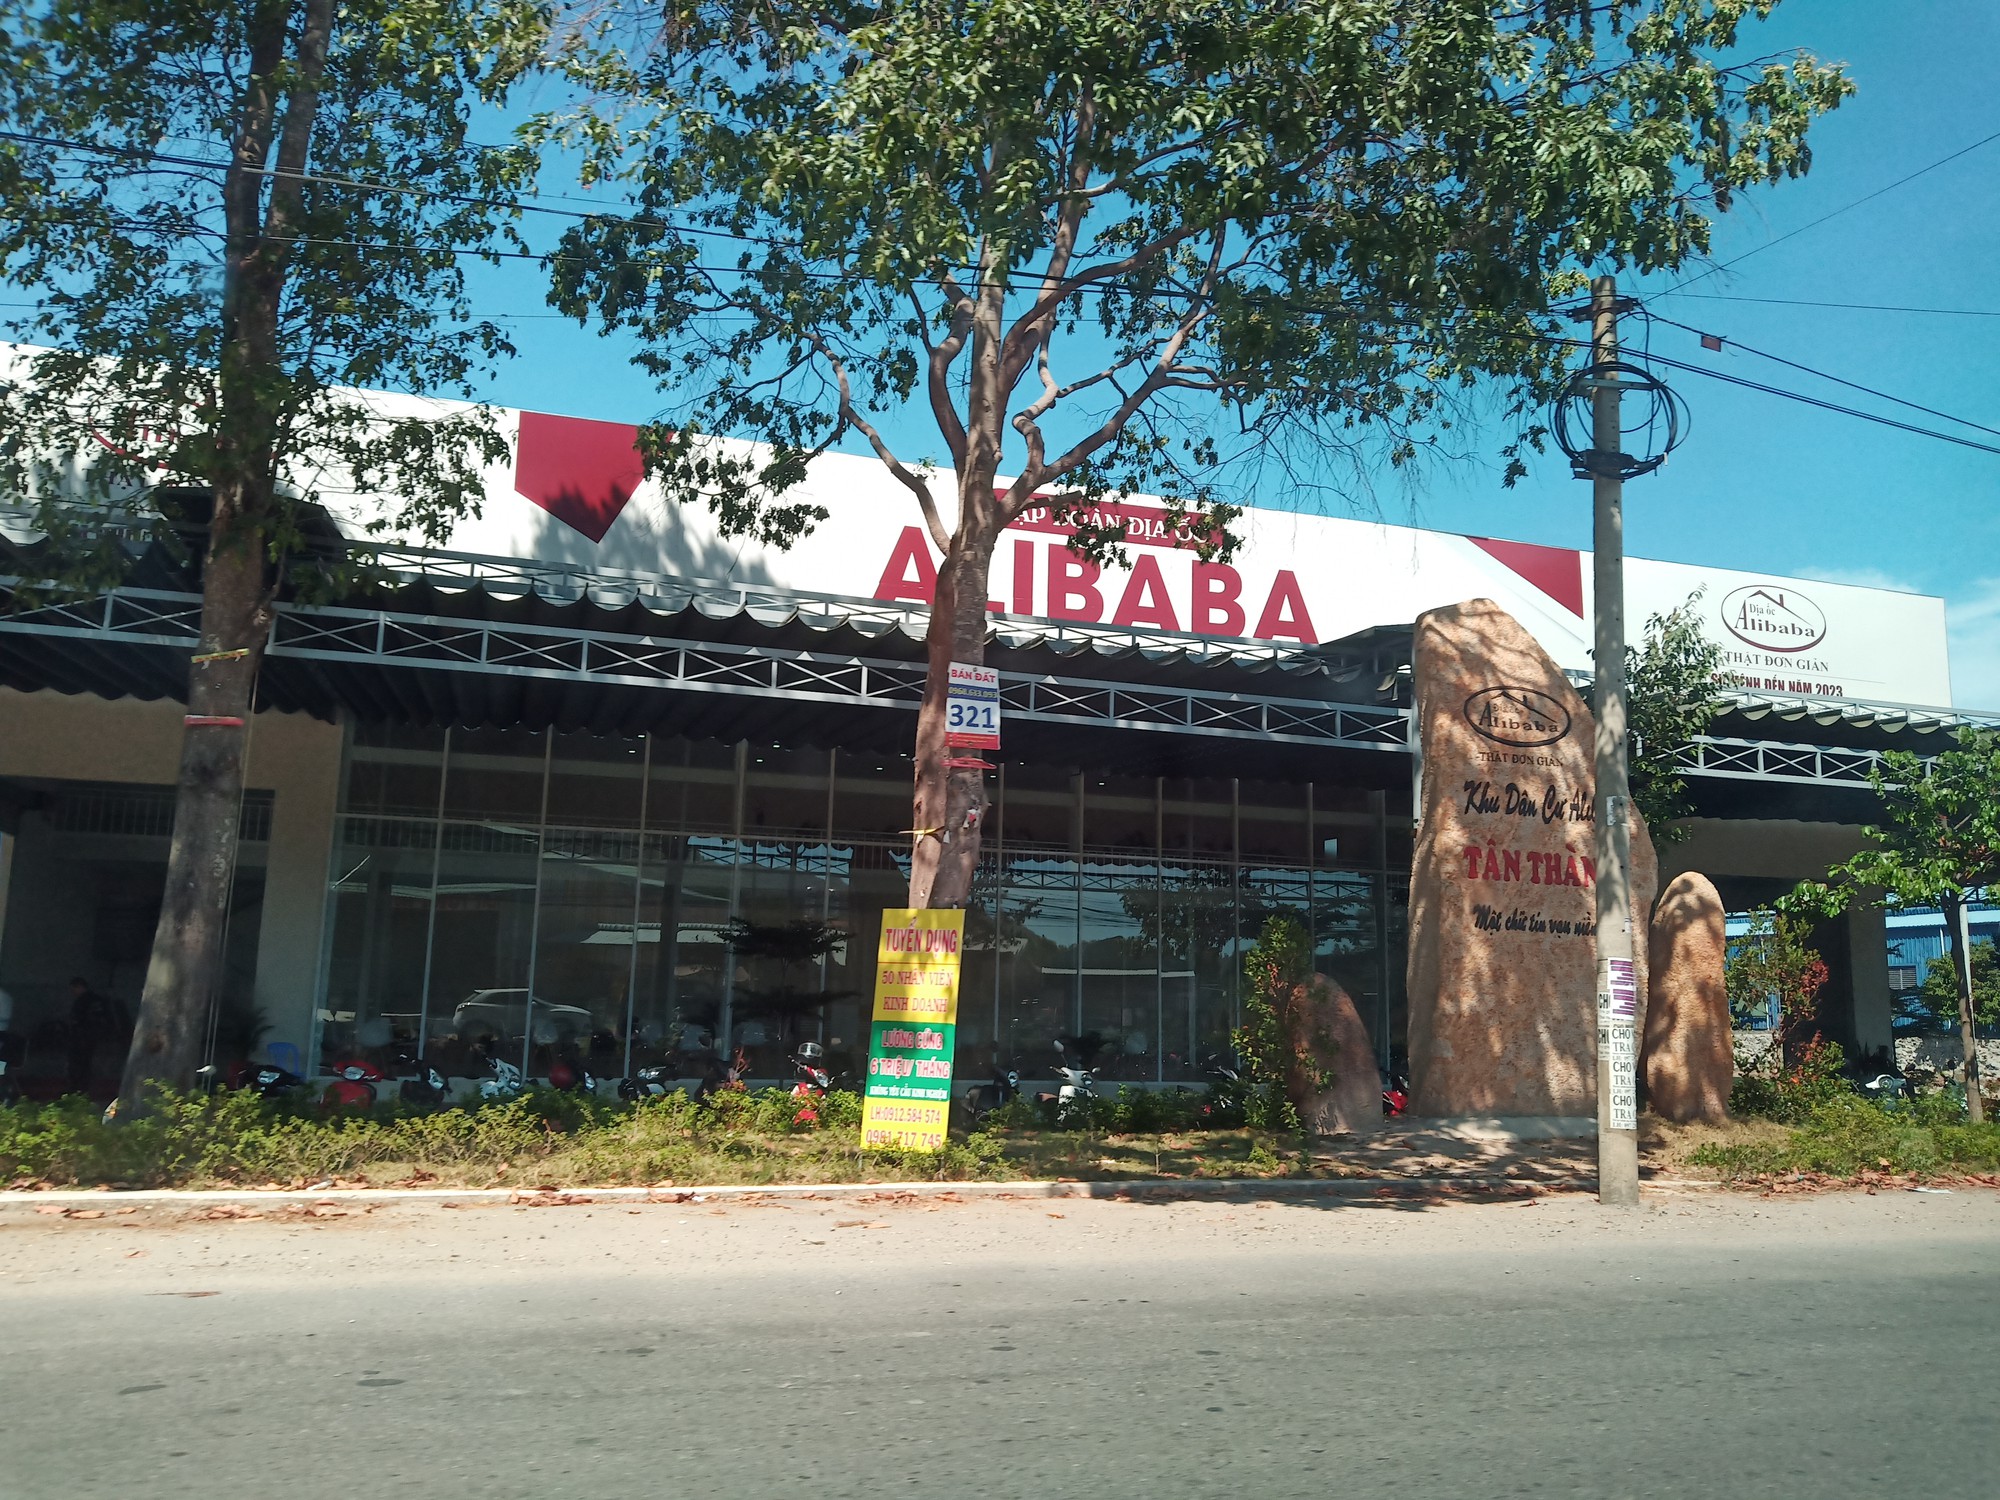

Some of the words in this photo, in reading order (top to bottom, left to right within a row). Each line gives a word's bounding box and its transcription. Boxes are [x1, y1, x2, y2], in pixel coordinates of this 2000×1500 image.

[1127, 516, 1168, 541] ĐỊA
[873, 525, 1320, 645] AIBABA
[1734, 599, 1816, 638] Alibaba
[1749, 603, 1764, 616] Địa
[1724, 651, 1761, 667] THẬT
[1765, 655, 1793, 669] ĐƠN
[951, 668, 972, 680] BÁN
[1789, 678, 1812, 694] NĂM
[1815, 683, 1843, 697] 2023
[949, 704, 995, 729] 321
[1478, 701, 1560, 732] Alibaba
[1463, 780, 1500, 815] Khu
[1505, 782, 1537, 817] Dân
[1541, 784, 1568, 824] Cư
[1463, 838, 1521, 882] TÂN
[1472, 903, 1502, 936] Một
[925, 929, 958, 957] DỤNG
[881, 970, 894, 985] 50
[896, 968, 925, 985] NHÂN
[929, 969, 953, 986] VIÊN
[882, 996, 909, 1011] KINH
[911, 997, 948, 1012] DOANH
[870, 1057, 879, 1075] 6
[915, 1056, 951, 1079] THÁNG
[925, 1109, 941, 1124] 574
[921, 1133, 942, 1148] 745
